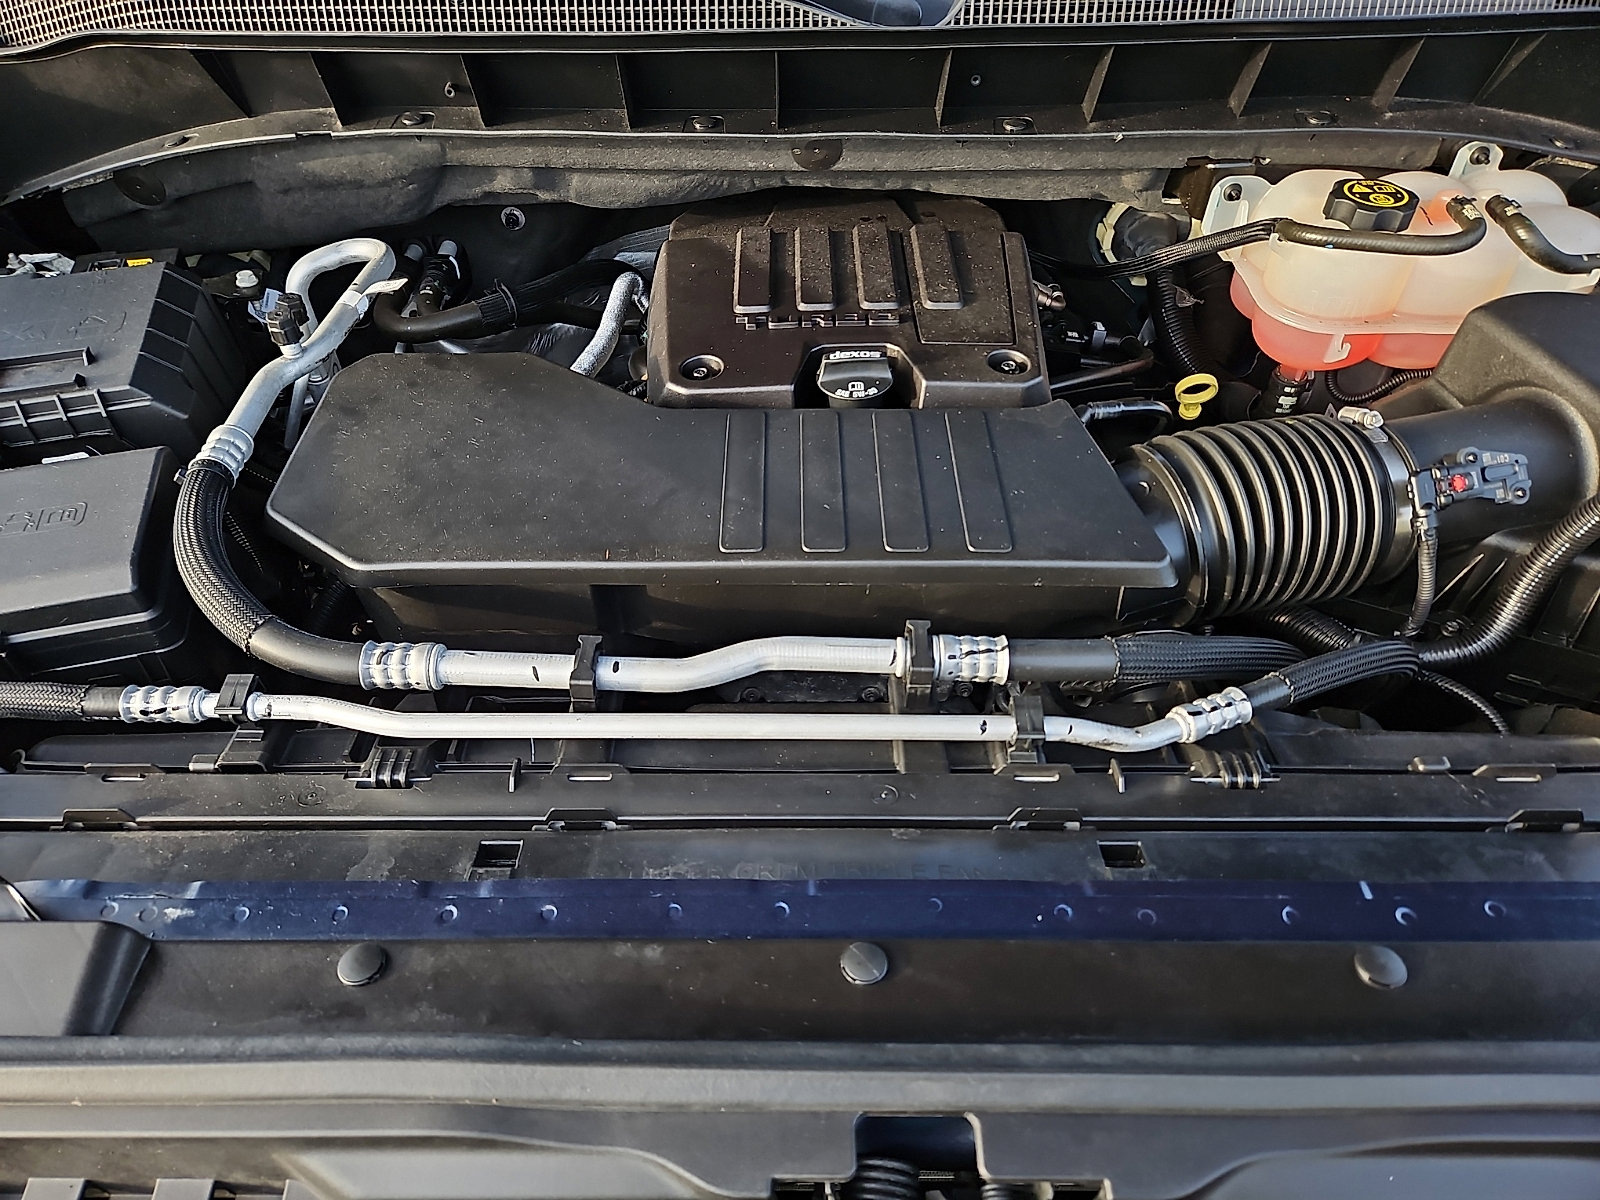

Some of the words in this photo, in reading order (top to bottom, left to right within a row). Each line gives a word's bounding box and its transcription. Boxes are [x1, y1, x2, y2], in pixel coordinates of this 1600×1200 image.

[735, 313, 899, 331] TURBO
[829, 351, 882, 360] dexos
[835, 389, 850, 398] SAE
